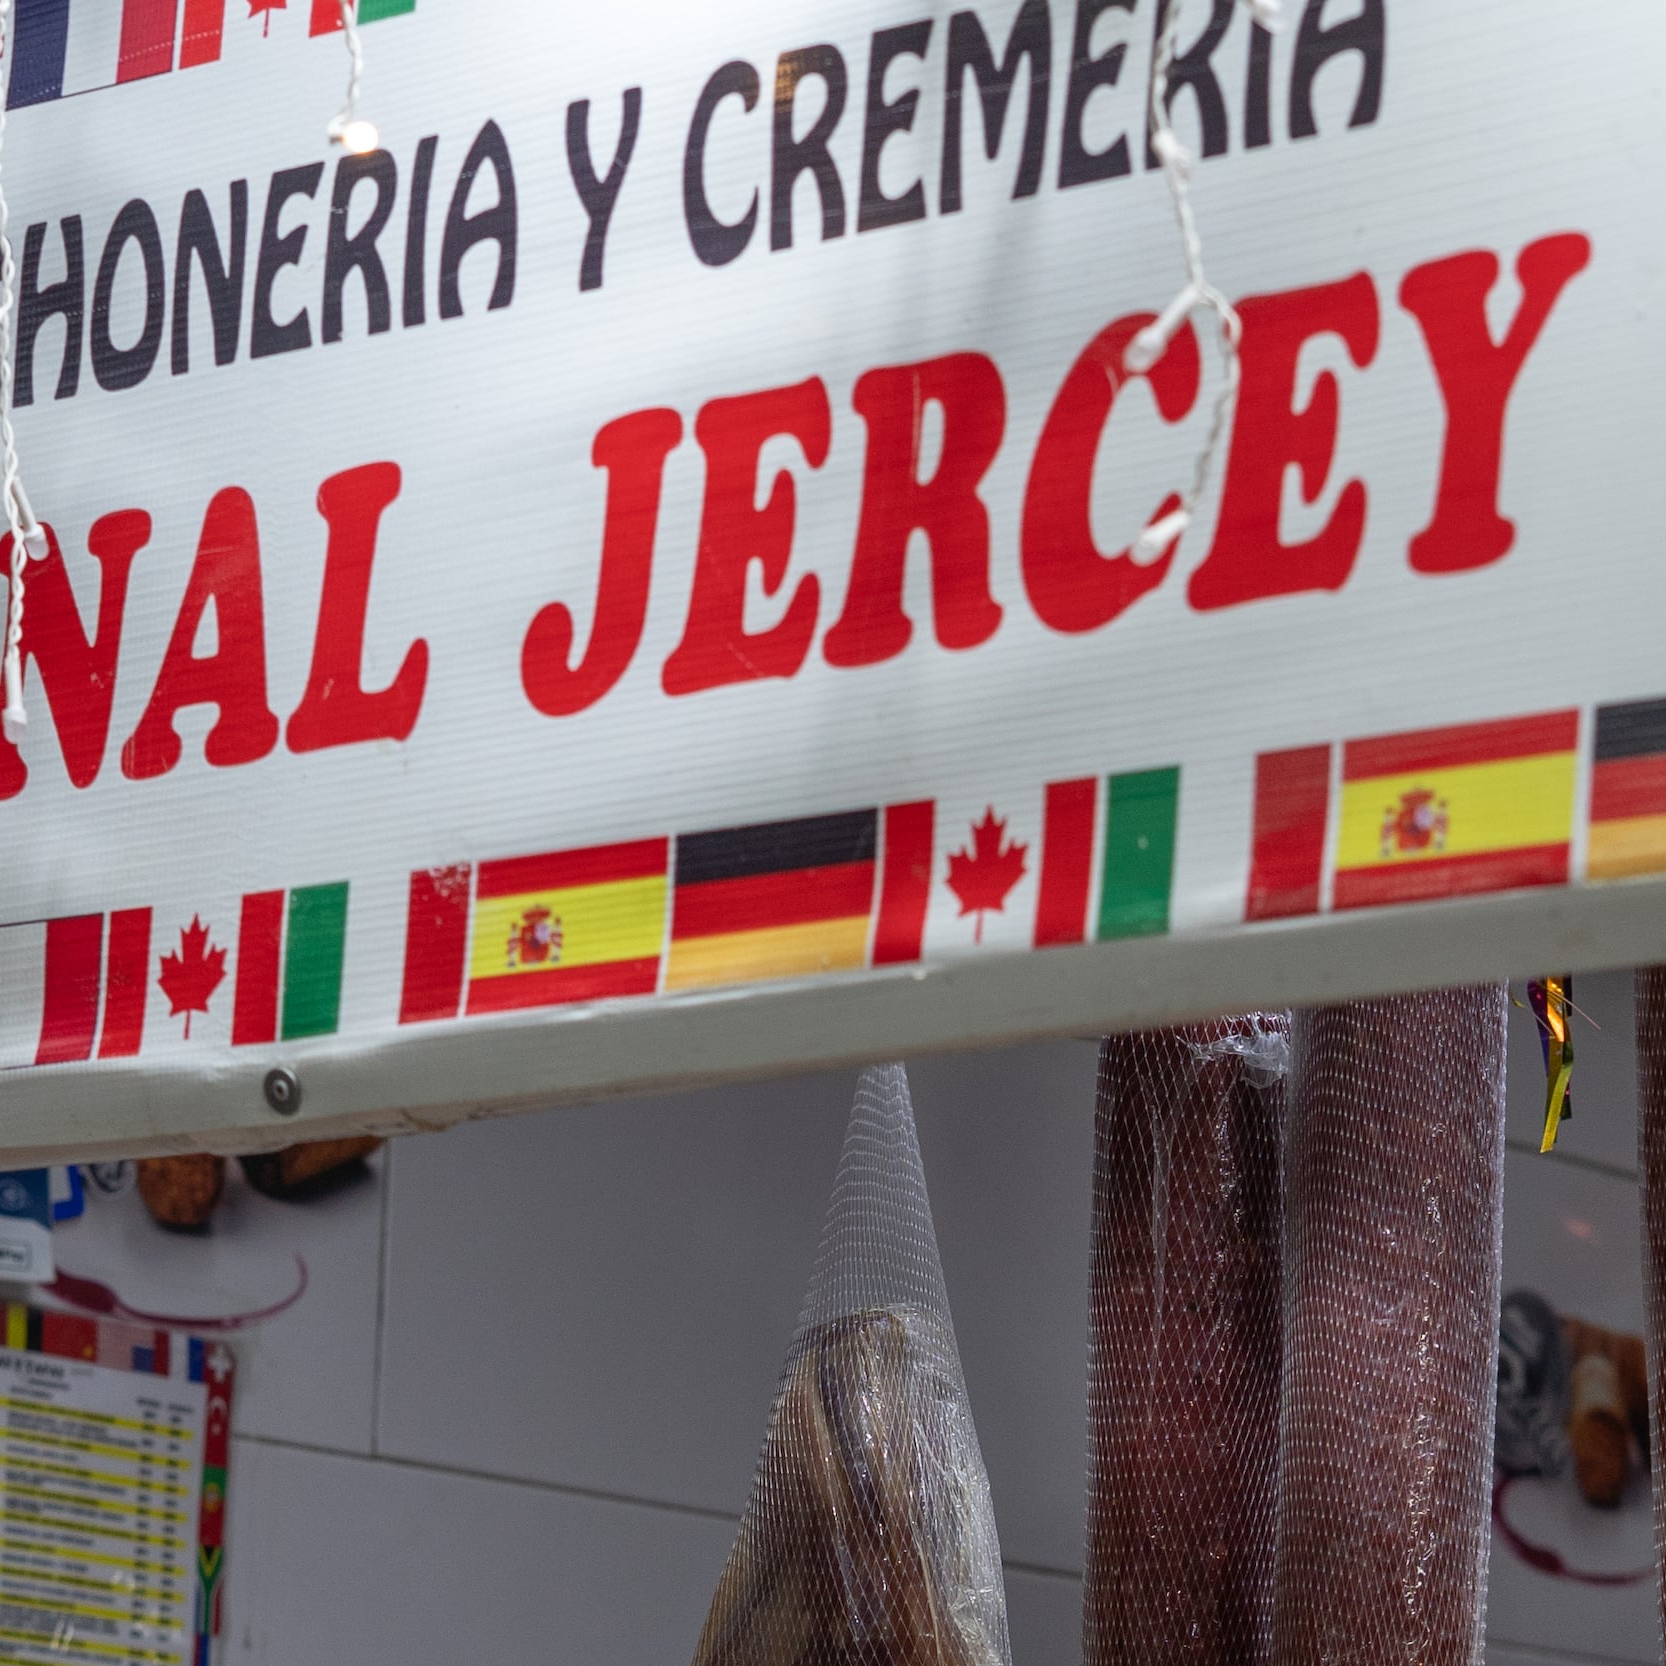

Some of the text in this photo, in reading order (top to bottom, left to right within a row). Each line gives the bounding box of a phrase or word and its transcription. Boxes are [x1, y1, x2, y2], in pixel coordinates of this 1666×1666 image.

[565, 86, 642, 293] Y
[683, 0, 1388, 267] CREMERIA
[521, 232, 1592, 717] JERCEY
